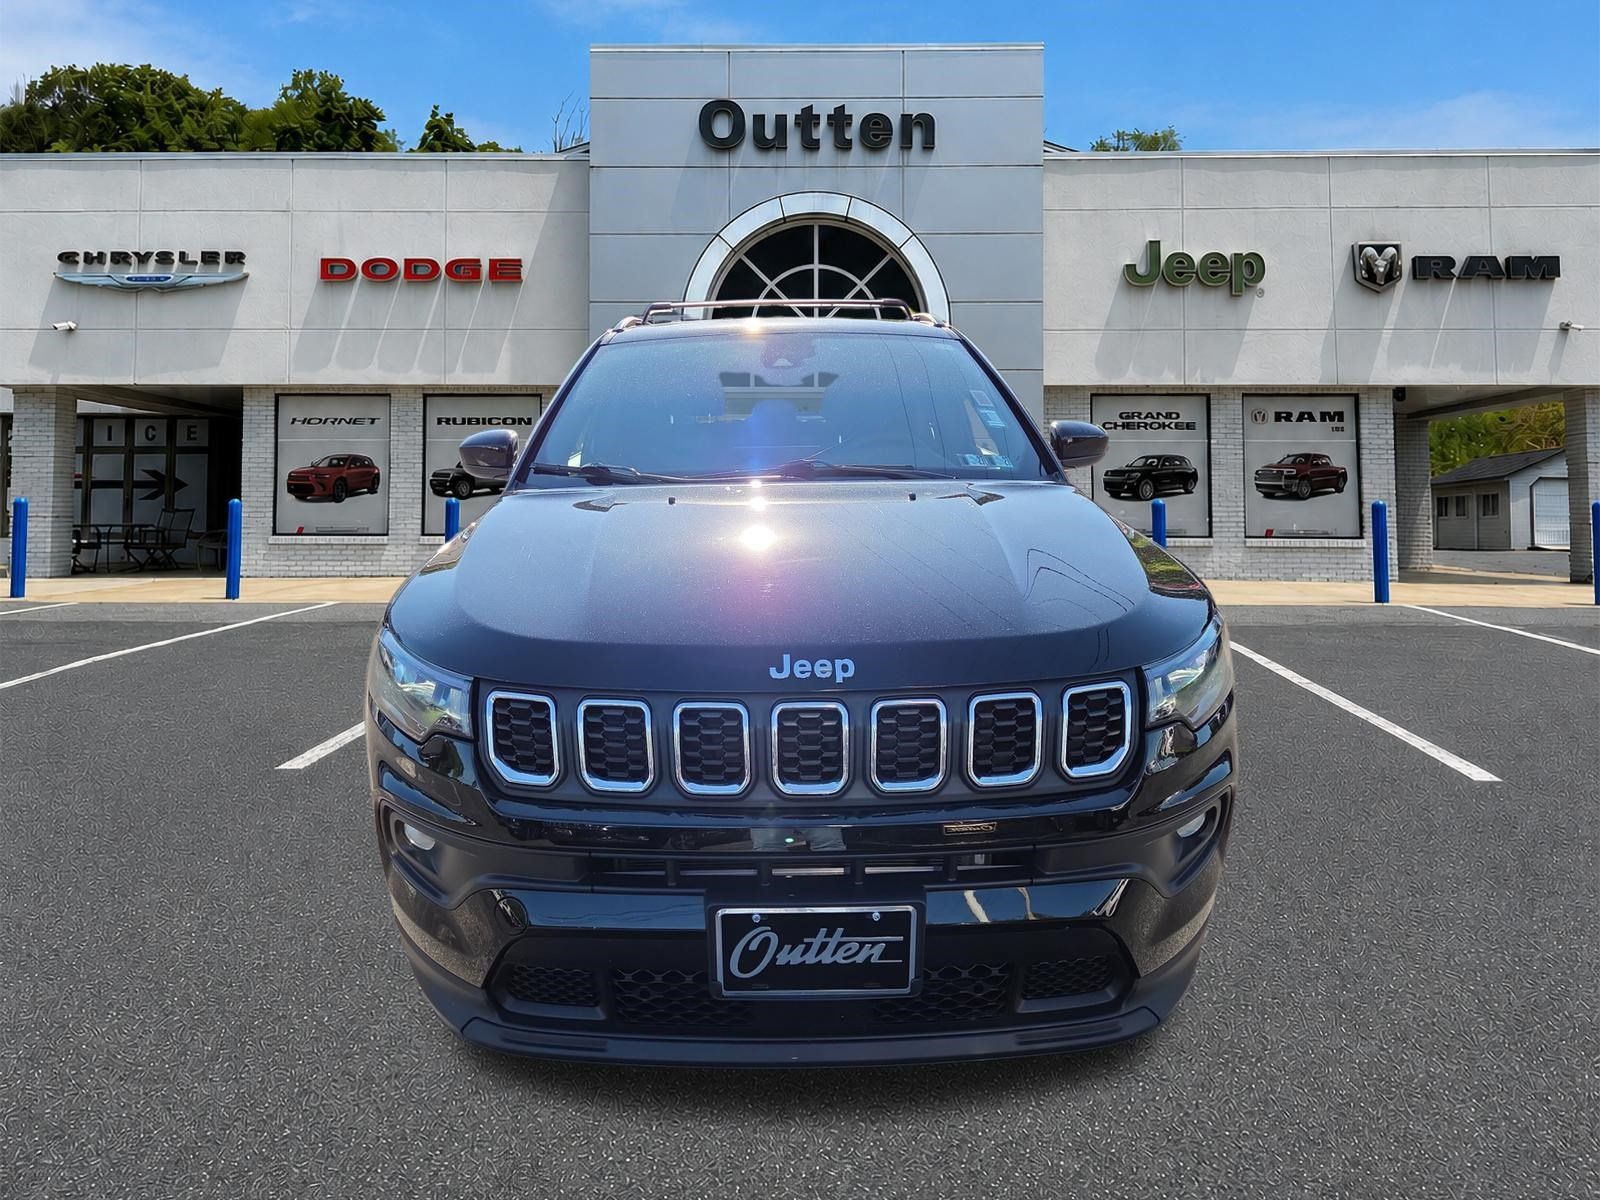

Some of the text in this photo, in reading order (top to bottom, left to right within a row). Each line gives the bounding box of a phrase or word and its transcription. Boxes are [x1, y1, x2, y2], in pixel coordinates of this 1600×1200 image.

[699, 99, 936, 150] Outten
[56, 250, 247, 266] CHRYSLER
[1123, 239, 1266, 297] Jeep
[1411, 255, 1561, 280] RAM
[319, 256, 523, 283] DODGE
[290, 417, 381, 426] HORNET
[436, 417, 533, 426] RUBICON
[1118, 411, 1181, 420] GRAND
[1274, 411, 1345, 423] RAM
[1101, 421, 1197, 431] CHEROKEE
[769, 653, 856, 683] Jeep
[729, 926, 904, 979] Outten
